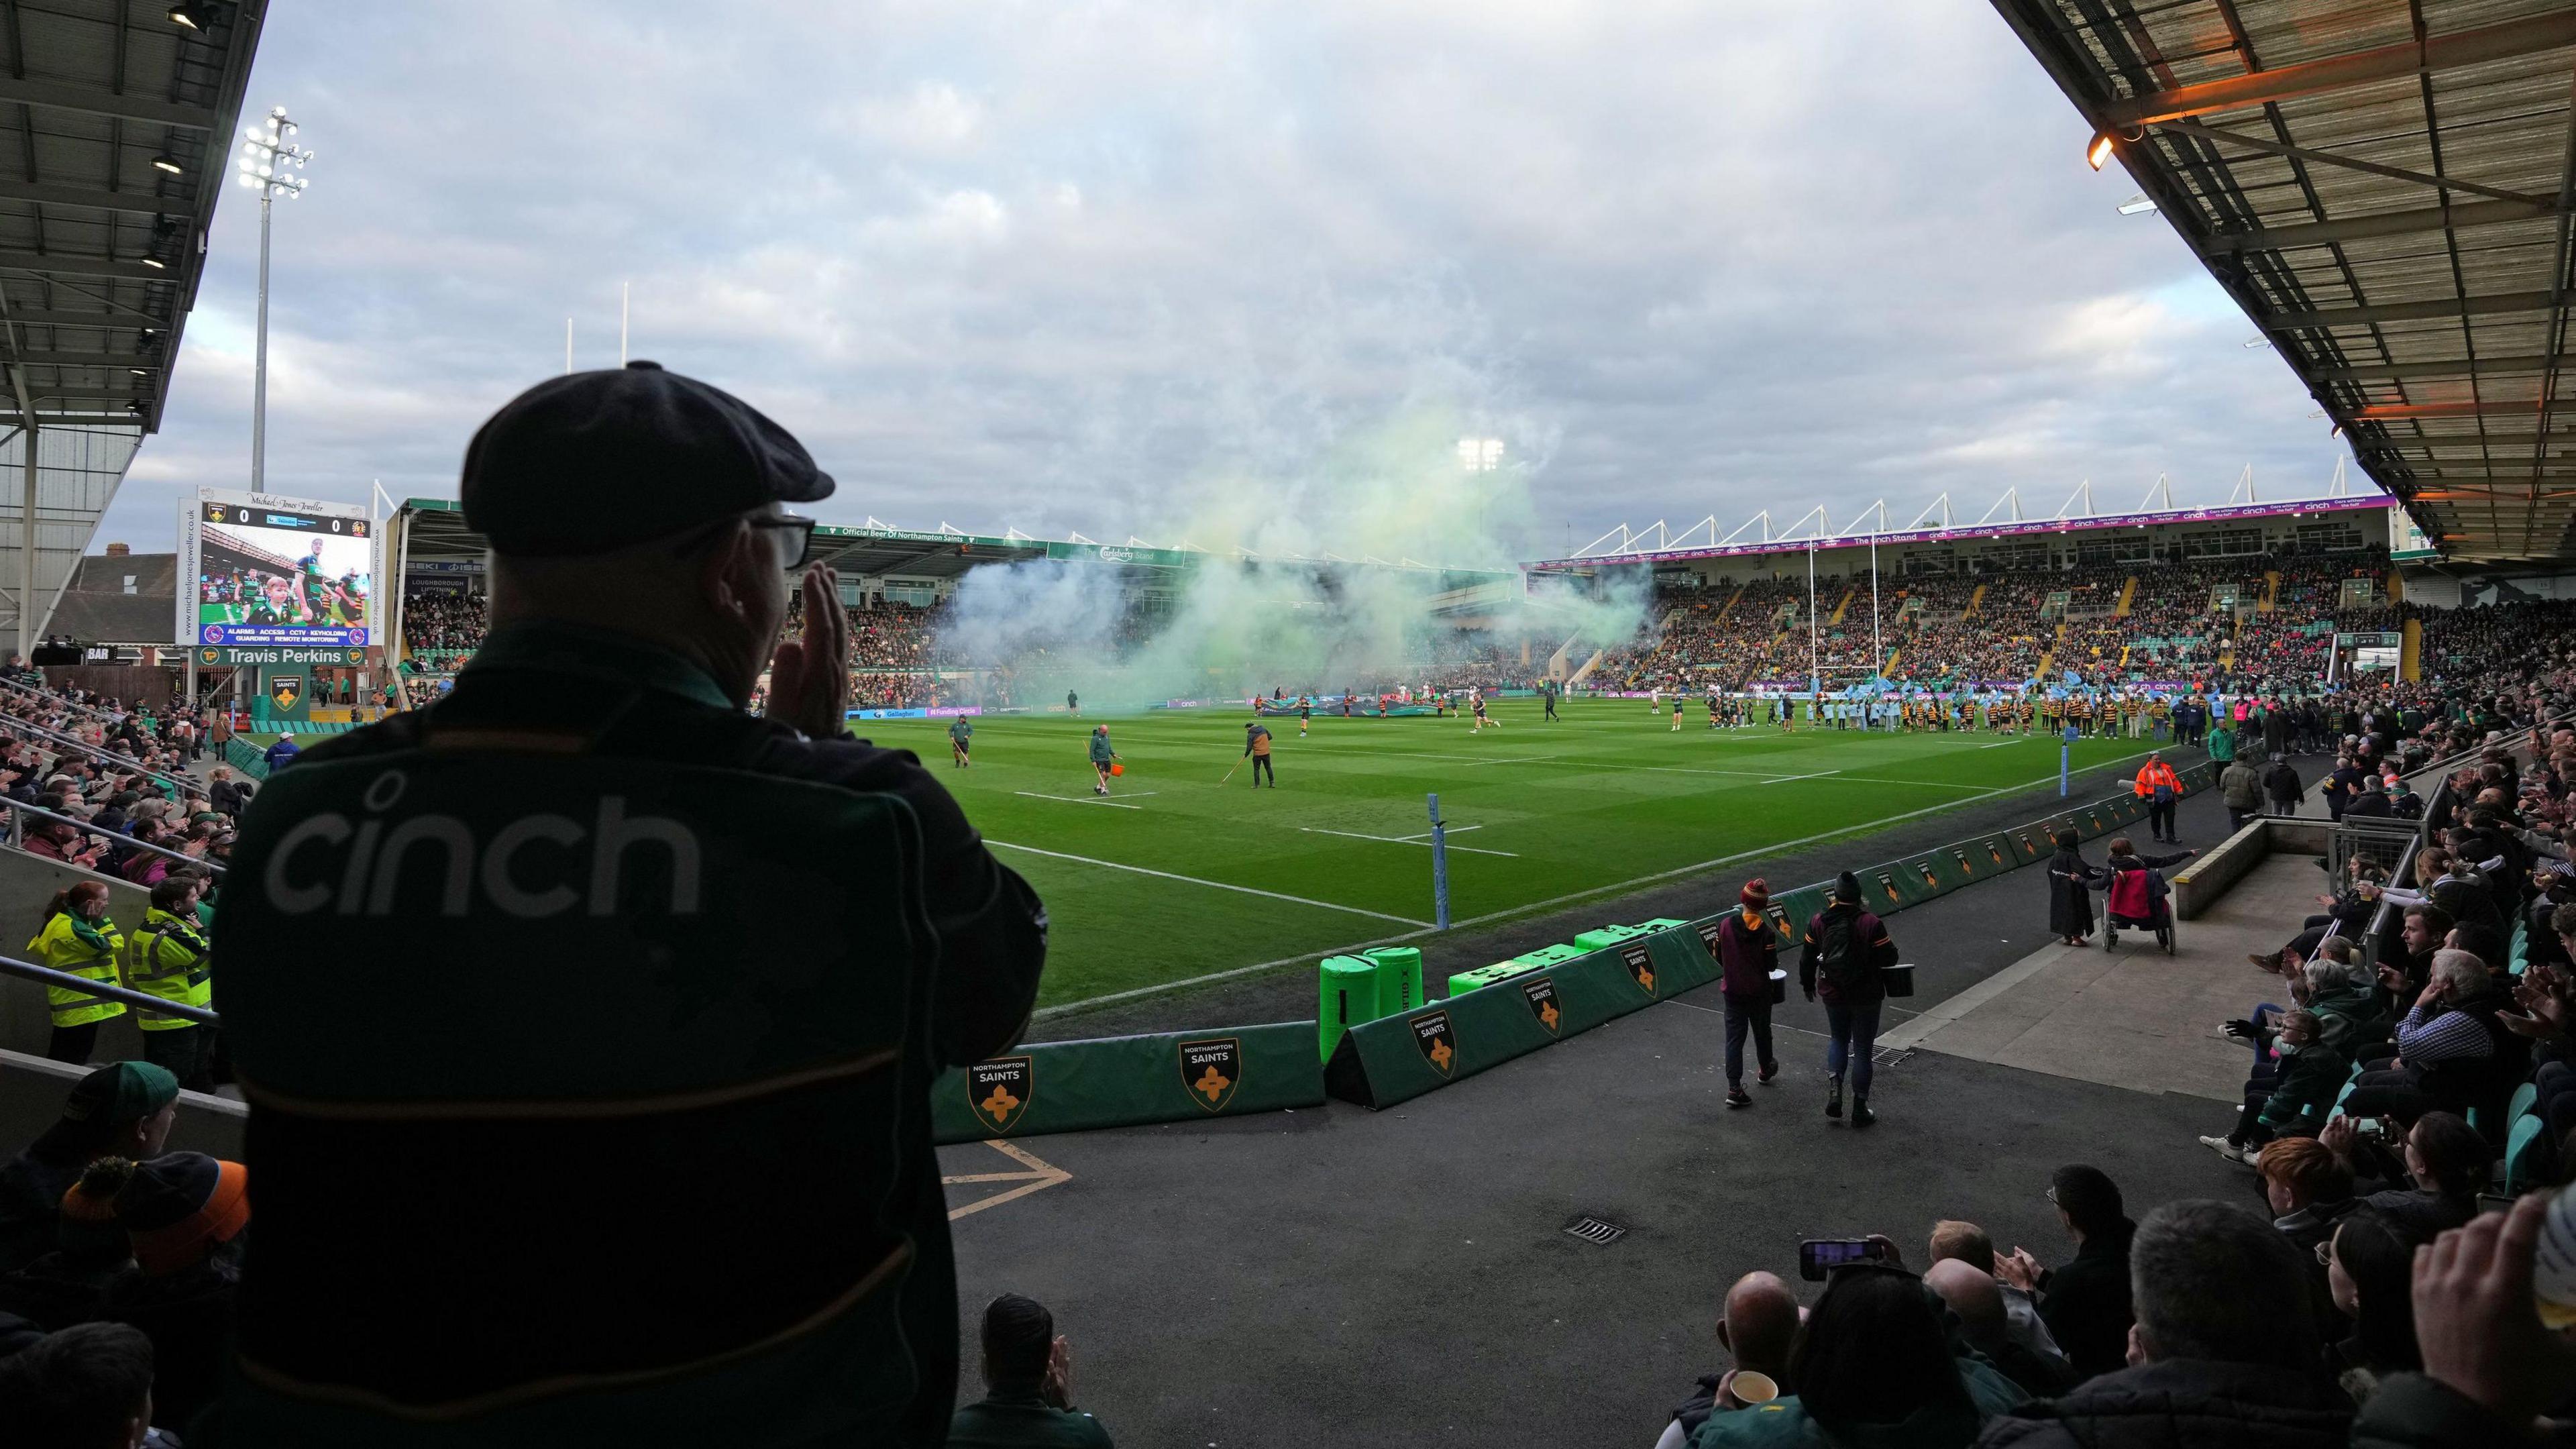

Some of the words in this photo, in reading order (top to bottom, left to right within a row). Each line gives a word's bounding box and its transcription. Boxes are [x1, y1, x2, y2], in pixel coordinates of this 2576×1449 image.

[247, 493, 279, 506] Michael
[279, 500, 297, 509] Jones
[297, 502, 323, 512] Jeweller
[2305, 502, 2329, 510] cinch
[239, 510, 249, 523] 0
[2243, 507, 2265, 515] cinch
[332, 520, 340, 532] 0
[842, 528, 869, 537] Official
[898, 531, 943, 541] Northampton
[1083, 548, 1096, 556] The
[1099, 547, 1133, 561] Carlsberg
[1136, 551, 1153, 560] Stand
[184, 510, 195, 636] www.michaeljonesjeweller.co.uk
[88, 648, 109, 660] BAR
[227, 649, 278, 663] Travis
[282, 649, 341, 663] Perkins
[265, 769, 700, 918] cinch
[1770, 910, 1784, 918] SAINTS
[1703, 931, 1718, 941] SAINTS
[1624, 949, 1646, 959] NORTHAMPTON
[1629, 955, 1646, 965] SAINTS
[1525, 982, 1552, 994] NORTHAMPTON
[1531, 989, 1552, 1001] SAINTS
[1414, 1016, 1445, 1030] NORTHAMPTON
[1421, 1024, 1445, 1038] SAINTS
[1185, 1044, 1234, 1053] NORTHAMPTON
[1191, 1052, 1229, 1064] SAINTS
[973, 1062, 1026, 1071] NORTHAMPTON
[979, 1071, 1020, 1082] SAINTS
